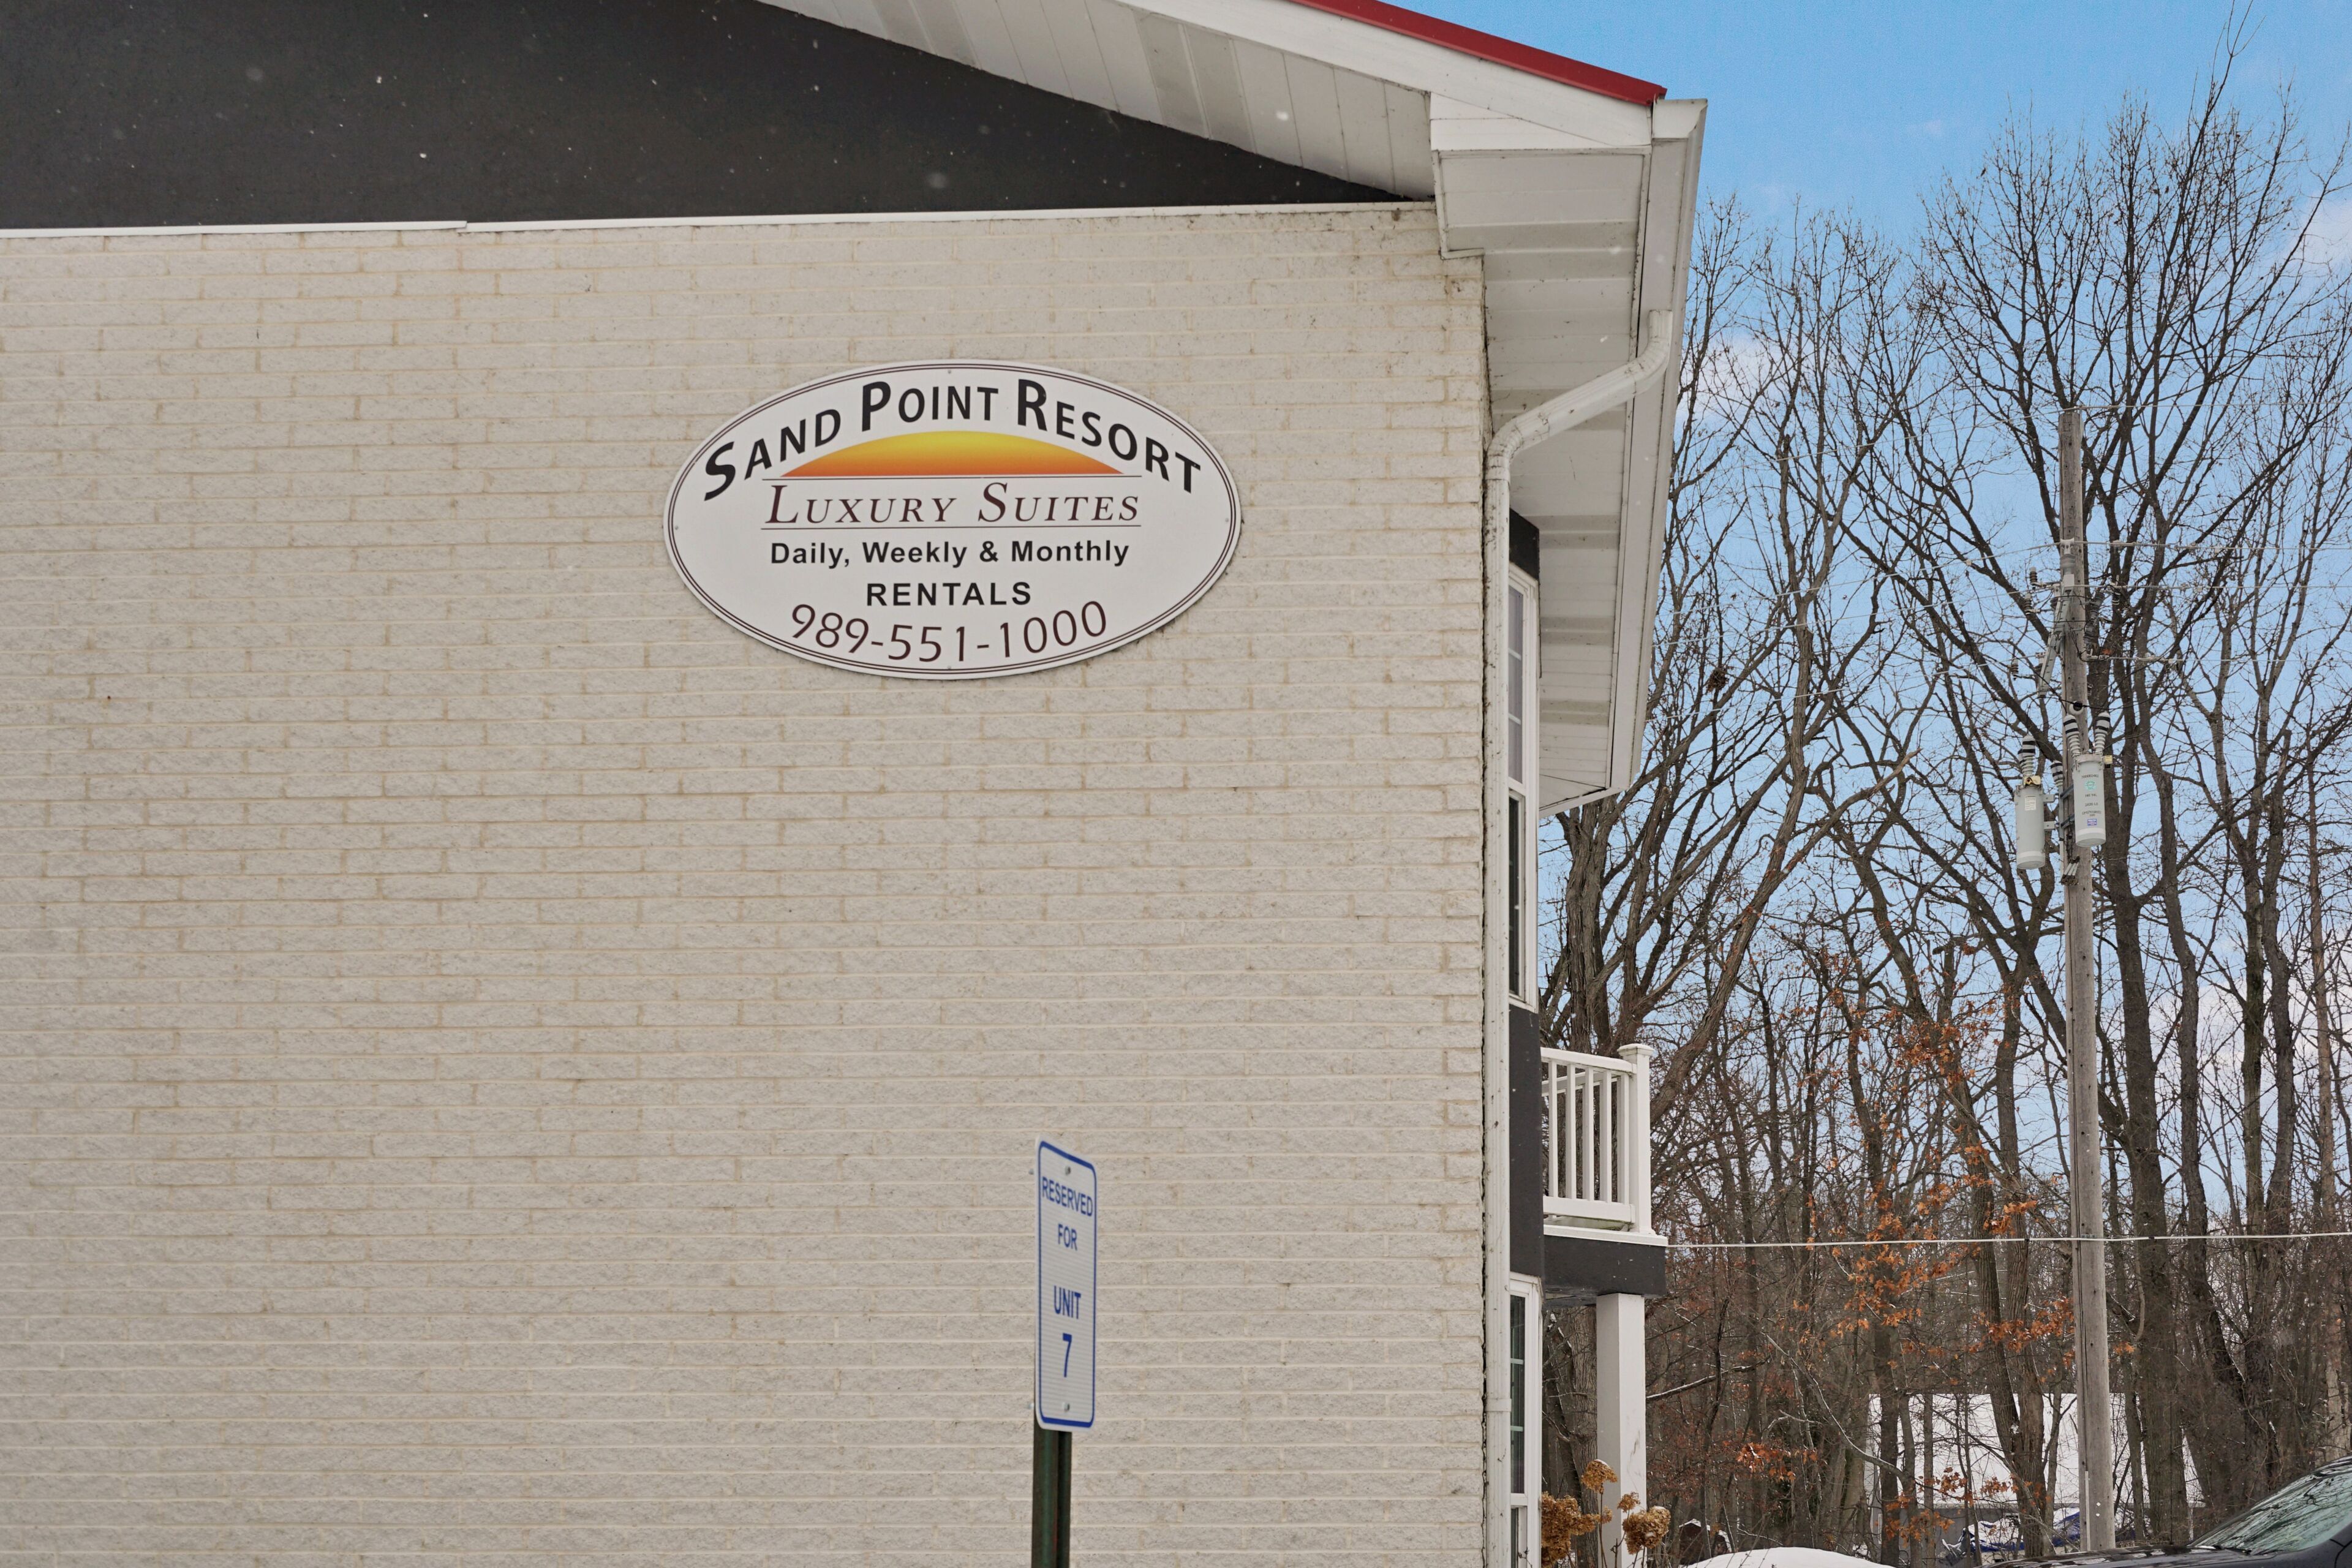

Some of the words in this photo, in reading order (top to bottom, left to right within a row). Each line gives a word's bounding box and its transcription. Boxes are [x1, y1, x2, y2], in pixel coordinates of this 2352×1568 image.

[704, 409, 841, 502] SAND
[862, 381, 1000, 432] POINT
[1017, 379, 1201, 494] RESORT
[764, 484, 957, 524] LUXURY
[978, 482, 1139, 522] SUITES
[771, 541, 850, 570] Daily,
[862, 541, 968, 568] Weekly
[979, 540, 999, 562] &
[1011, 540, 1129, 567] Monthly
[867, 581, 1031, 606] RENTALS
[791, 600, 1107, 662] 989-551-1000
[1042, 1176, 1093, 1217] RESERVED
[1057, 1223, 1078, 1251] FOR
[1054, 1285, 1082, 1319] UNIT
[1062, 1332, 1072, 1378] 7
